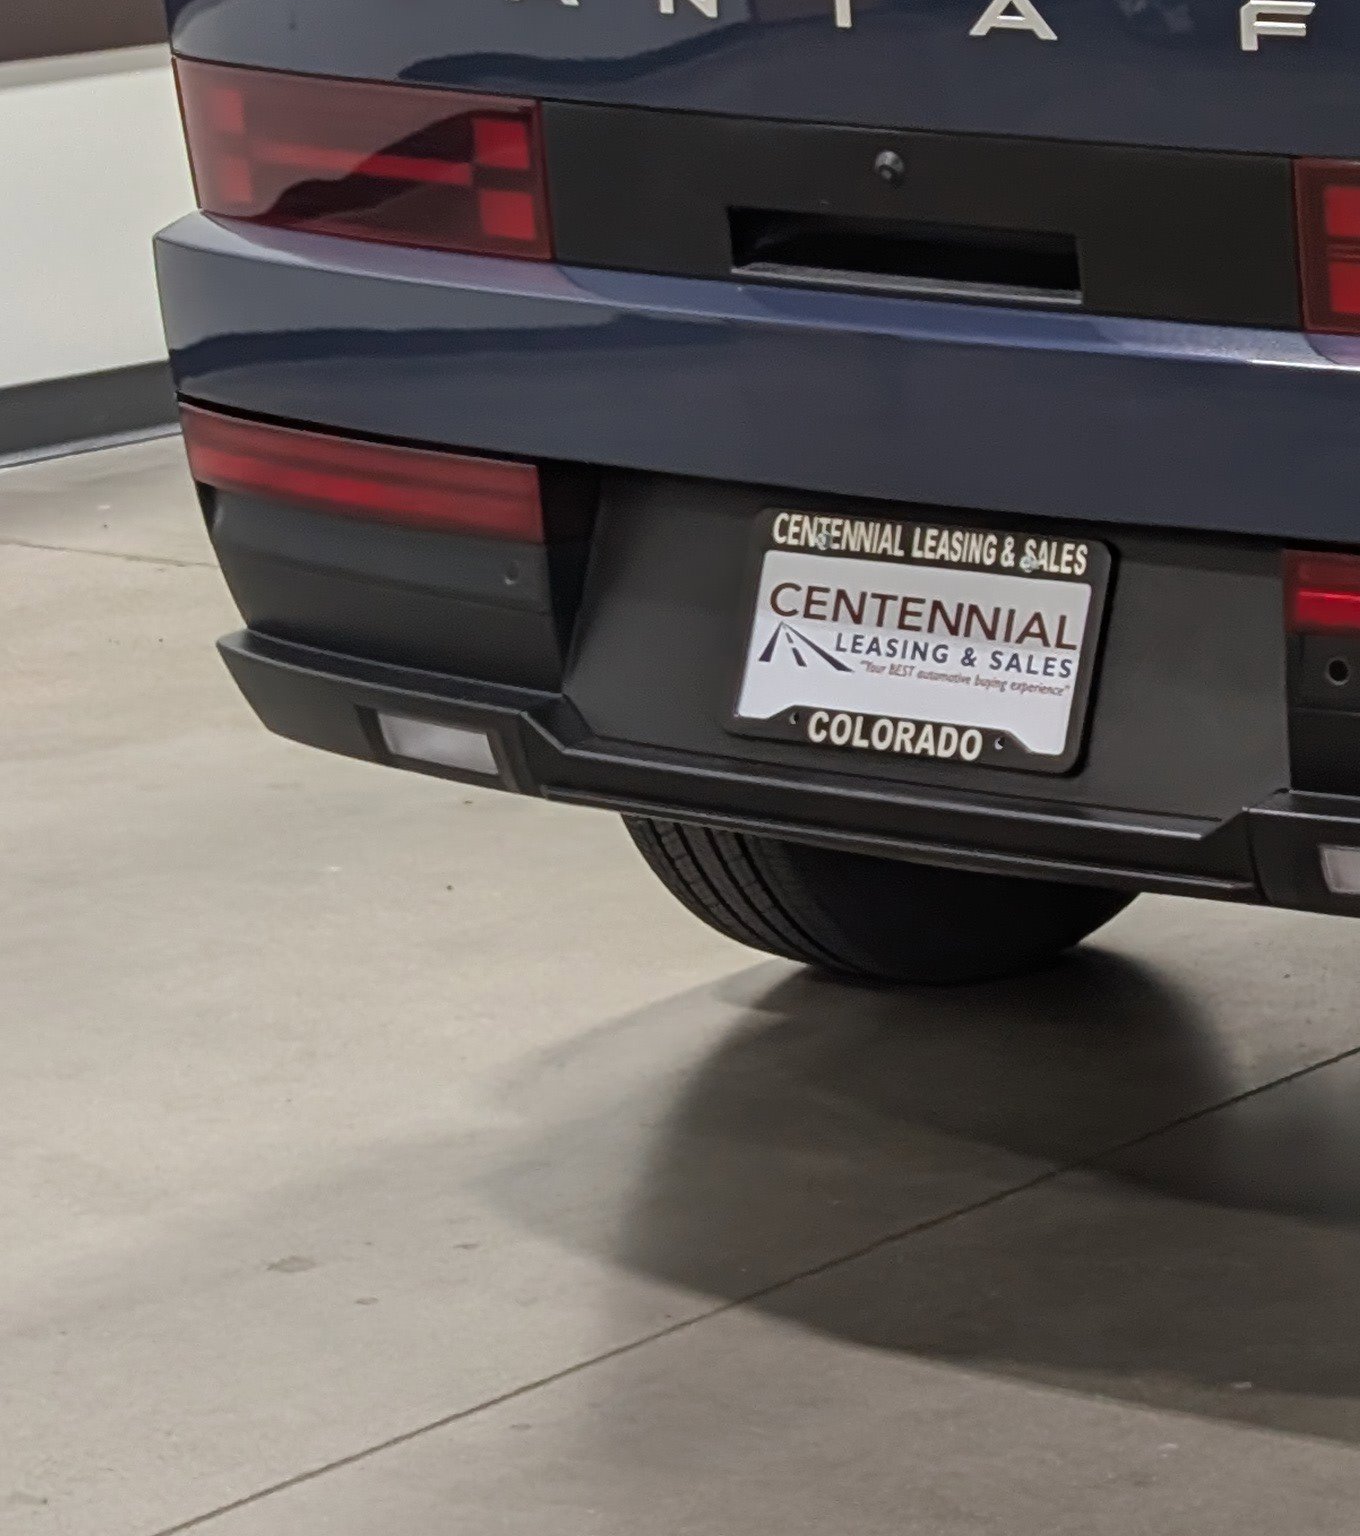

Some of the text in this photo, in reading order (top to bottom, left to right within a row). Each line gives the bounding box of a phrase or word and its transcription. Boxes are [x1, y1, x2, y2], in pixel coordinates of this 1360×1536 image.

[772, 512, 1088, 576] CENTENNIAL LEASING & SALES
[770, 582, 1078, 650] CENTENNIAL
[835, 632, 1073, 679] LEASING & SALES
[888, 663, 916, 677] BEST
[917, 670, 971, 685] automotive
[974, 674, 1008, 693] buying
[807, 710, 983, 762] COLORADO
